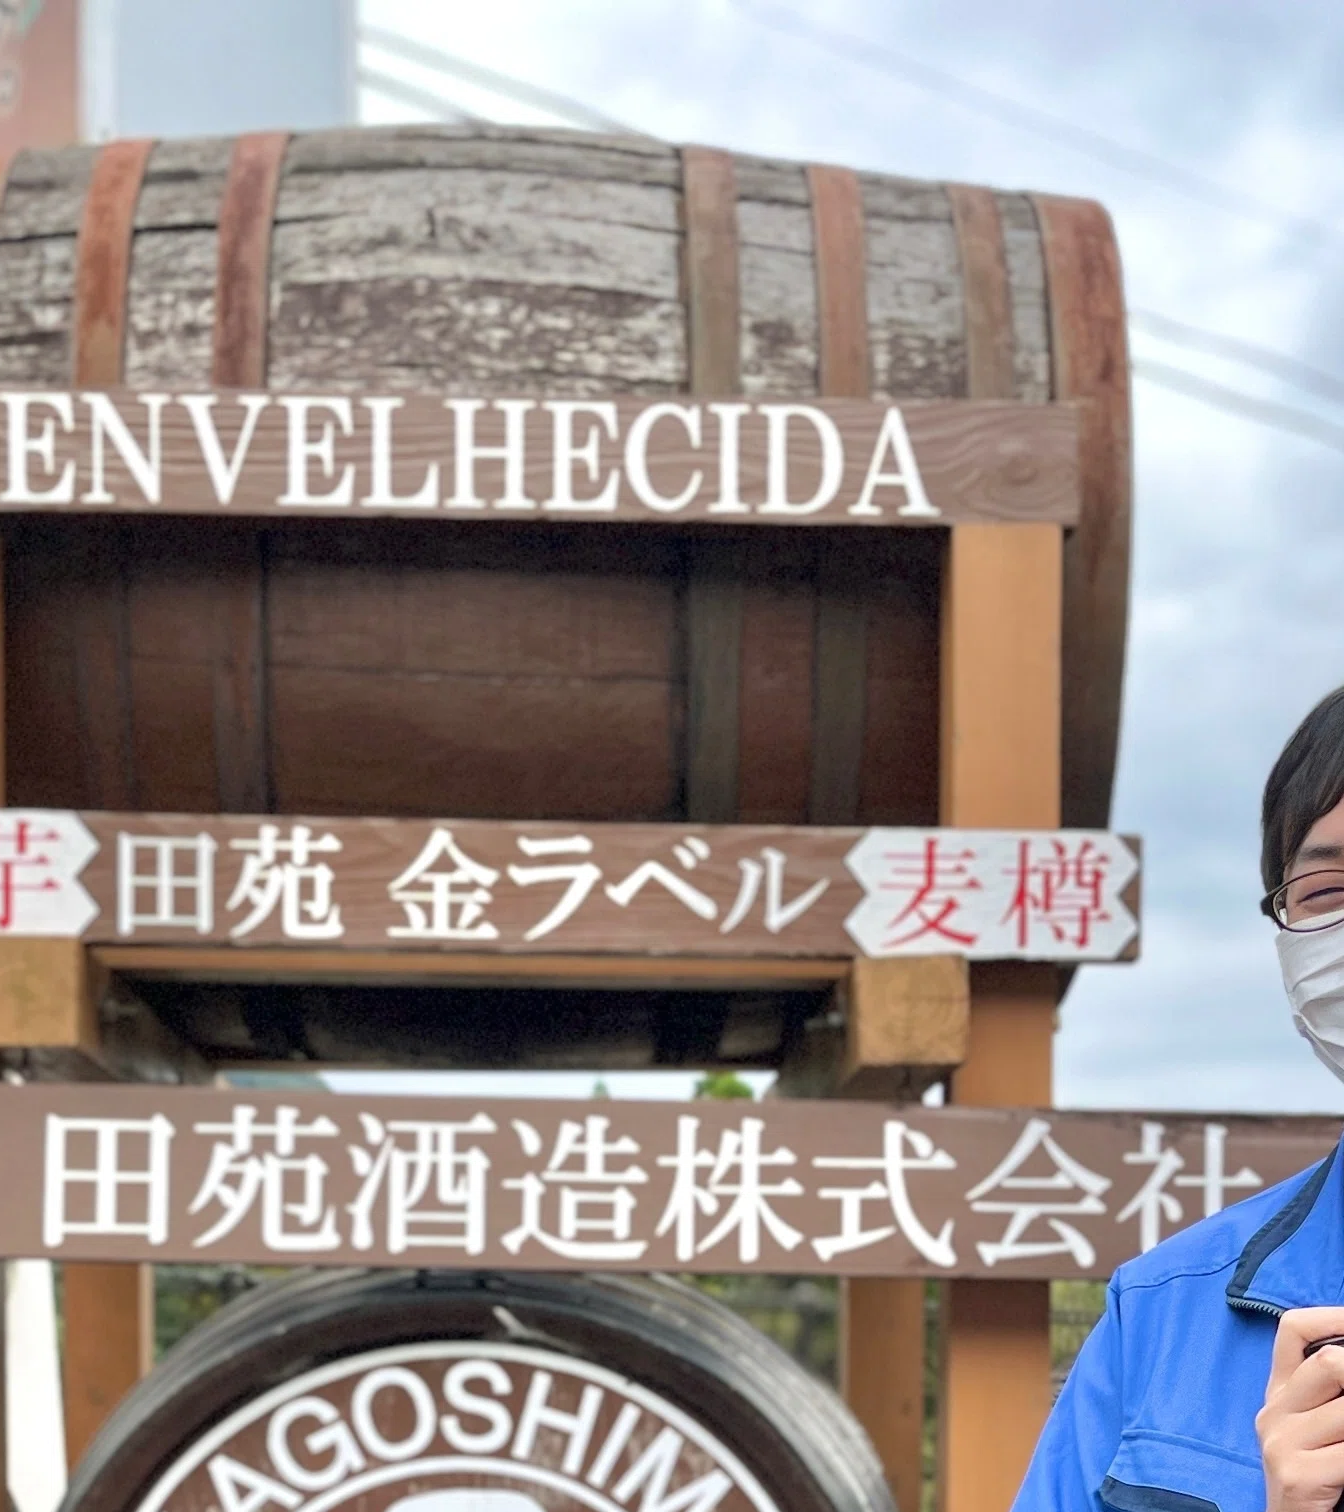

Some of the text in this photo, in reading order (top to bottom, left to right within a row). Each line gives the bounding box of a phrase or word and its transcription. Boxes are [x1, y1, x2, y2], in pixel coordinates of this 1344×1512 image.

[116, 824, 830, 940] 田苑 金ラベル
[880, 836, 1113, 951] 麦樽
[42, 1105, 1264, 1268] 田苑酒造株式会社
